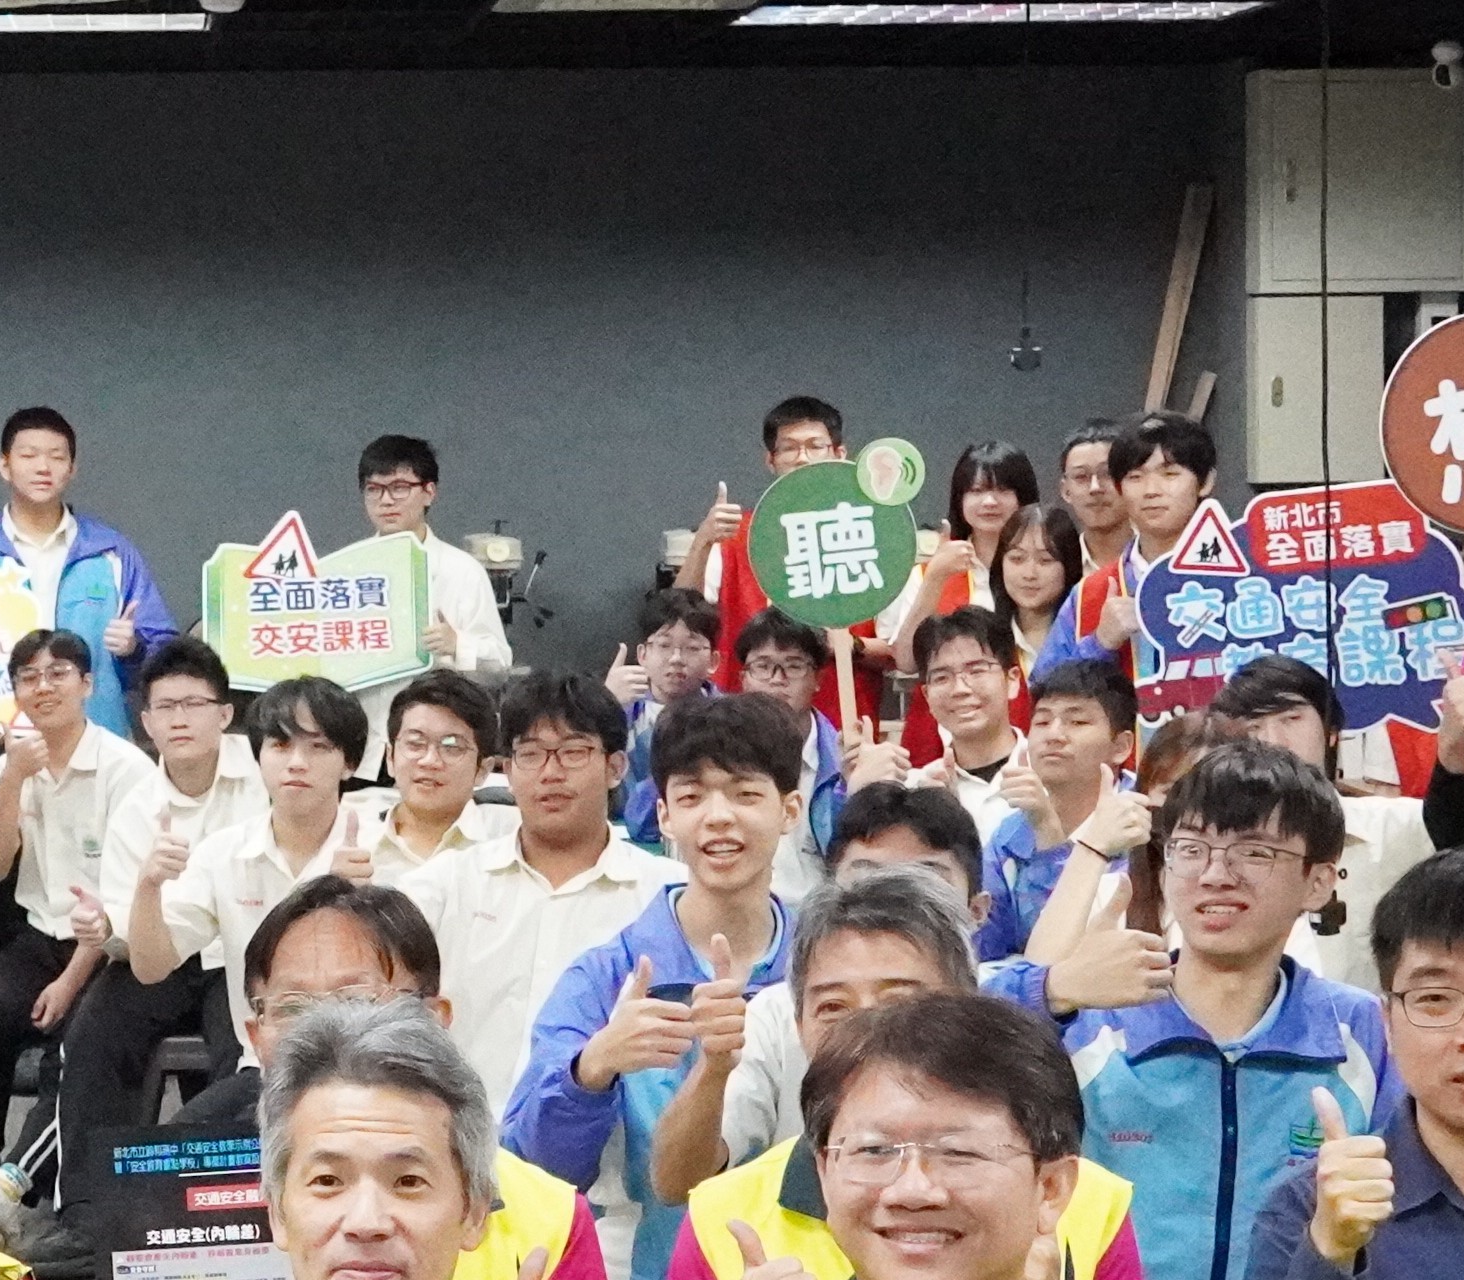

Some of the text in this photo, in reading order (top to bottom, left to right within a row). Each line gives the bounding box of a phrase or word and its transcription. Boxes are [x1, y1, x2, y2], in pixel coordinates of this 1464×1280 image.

[1264, 501, 1341, 531] 新北市
[780, 502, 884, 599] 聽
[1267, 520, 1414, 566] 全面落實
[249, 577, 387, 613] 全面落實
[1166, 574, 1389, 648] 交通安全
[252, 619, 391, 655] 交安課程
[194, 1188, 263, 1207] 交通安全融
